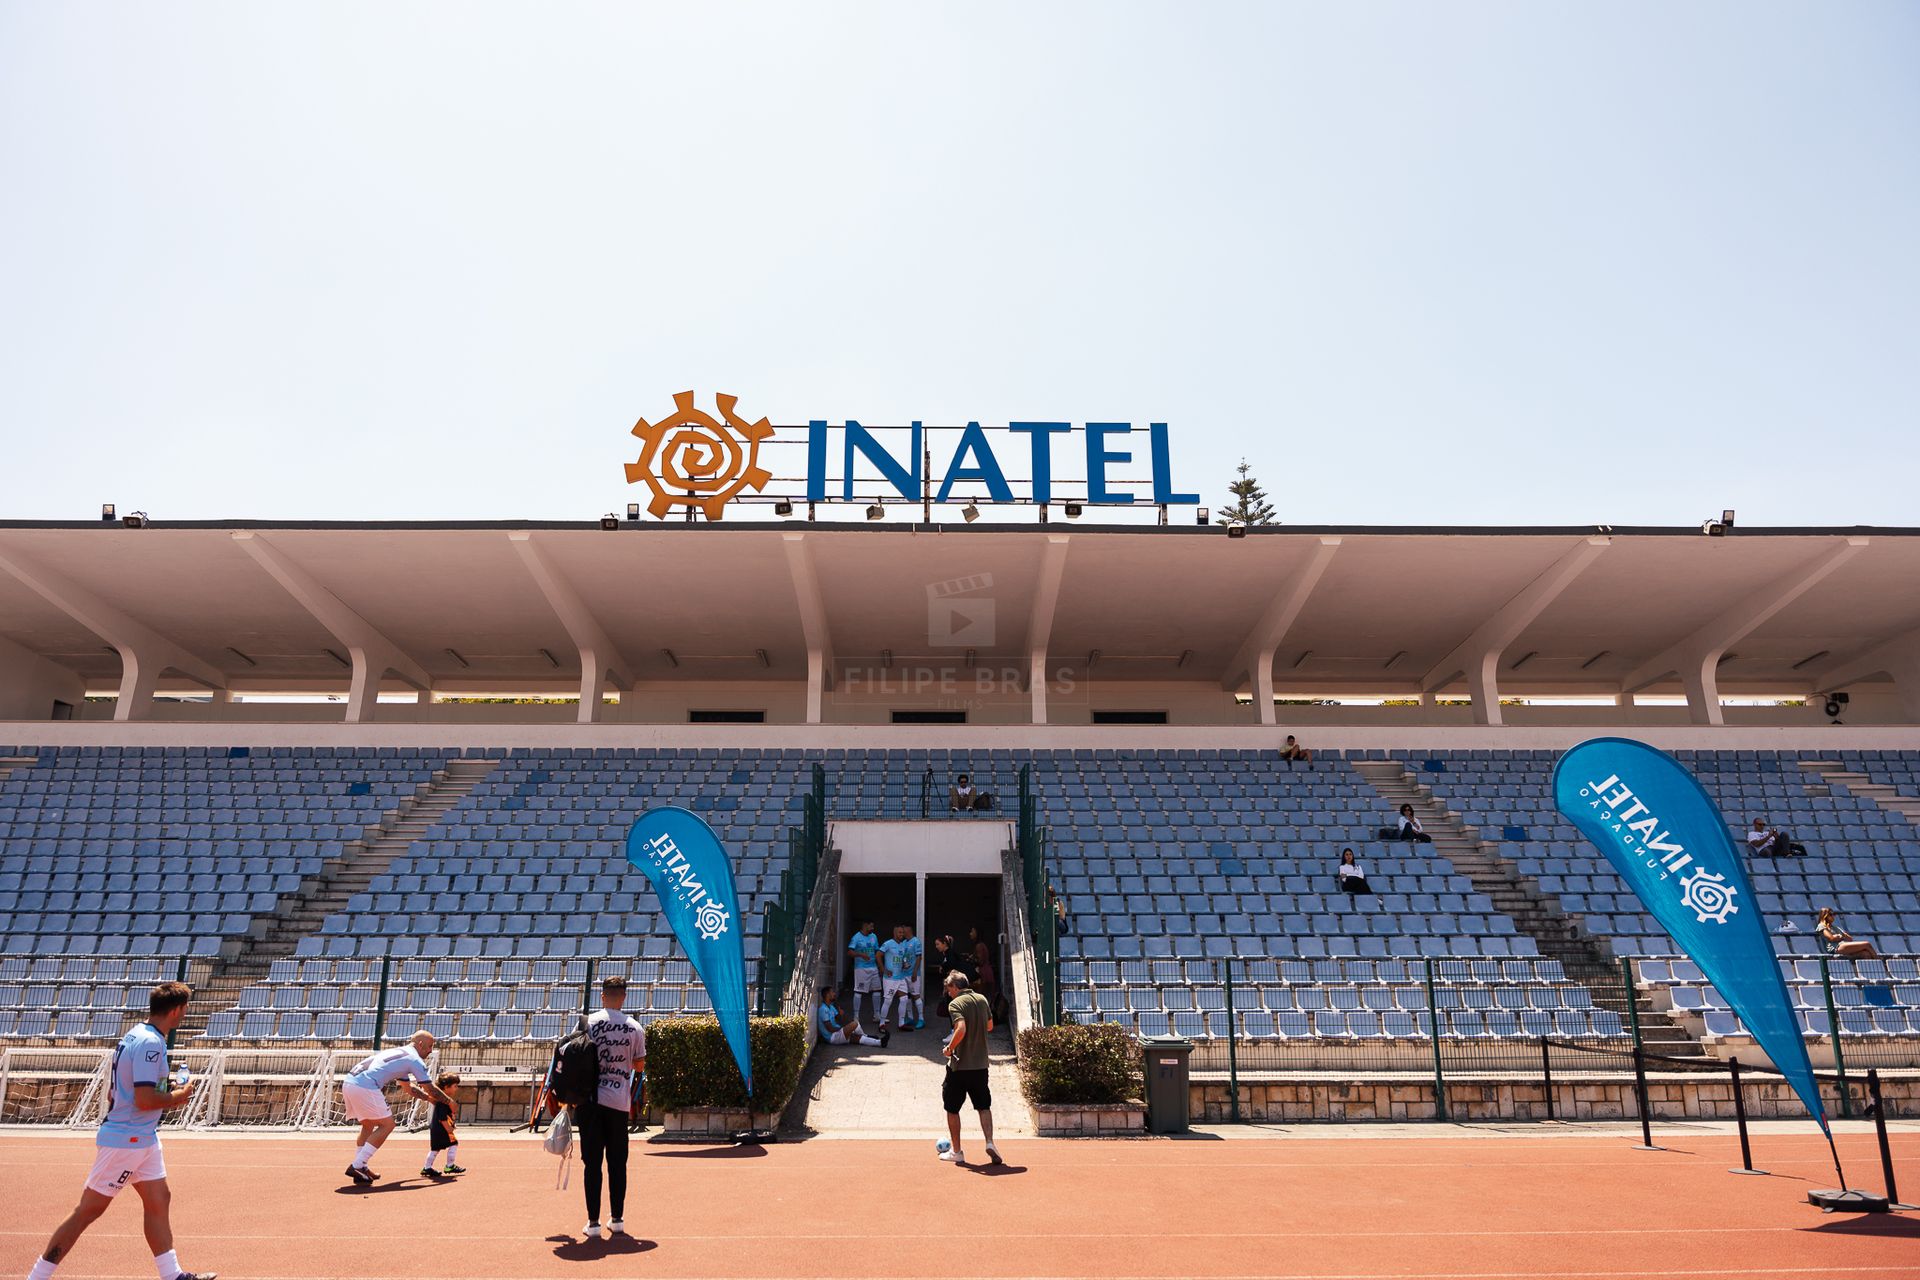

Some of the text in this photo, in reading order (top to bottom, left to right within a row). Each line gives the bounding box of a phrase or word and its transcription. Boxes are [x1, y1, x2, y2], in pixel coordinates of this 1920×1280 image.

[807, 420, 1200, 504] INATEL
[595, 1036, 631, 1047] Paris
[598, 1048, 626, 1063] Rue
